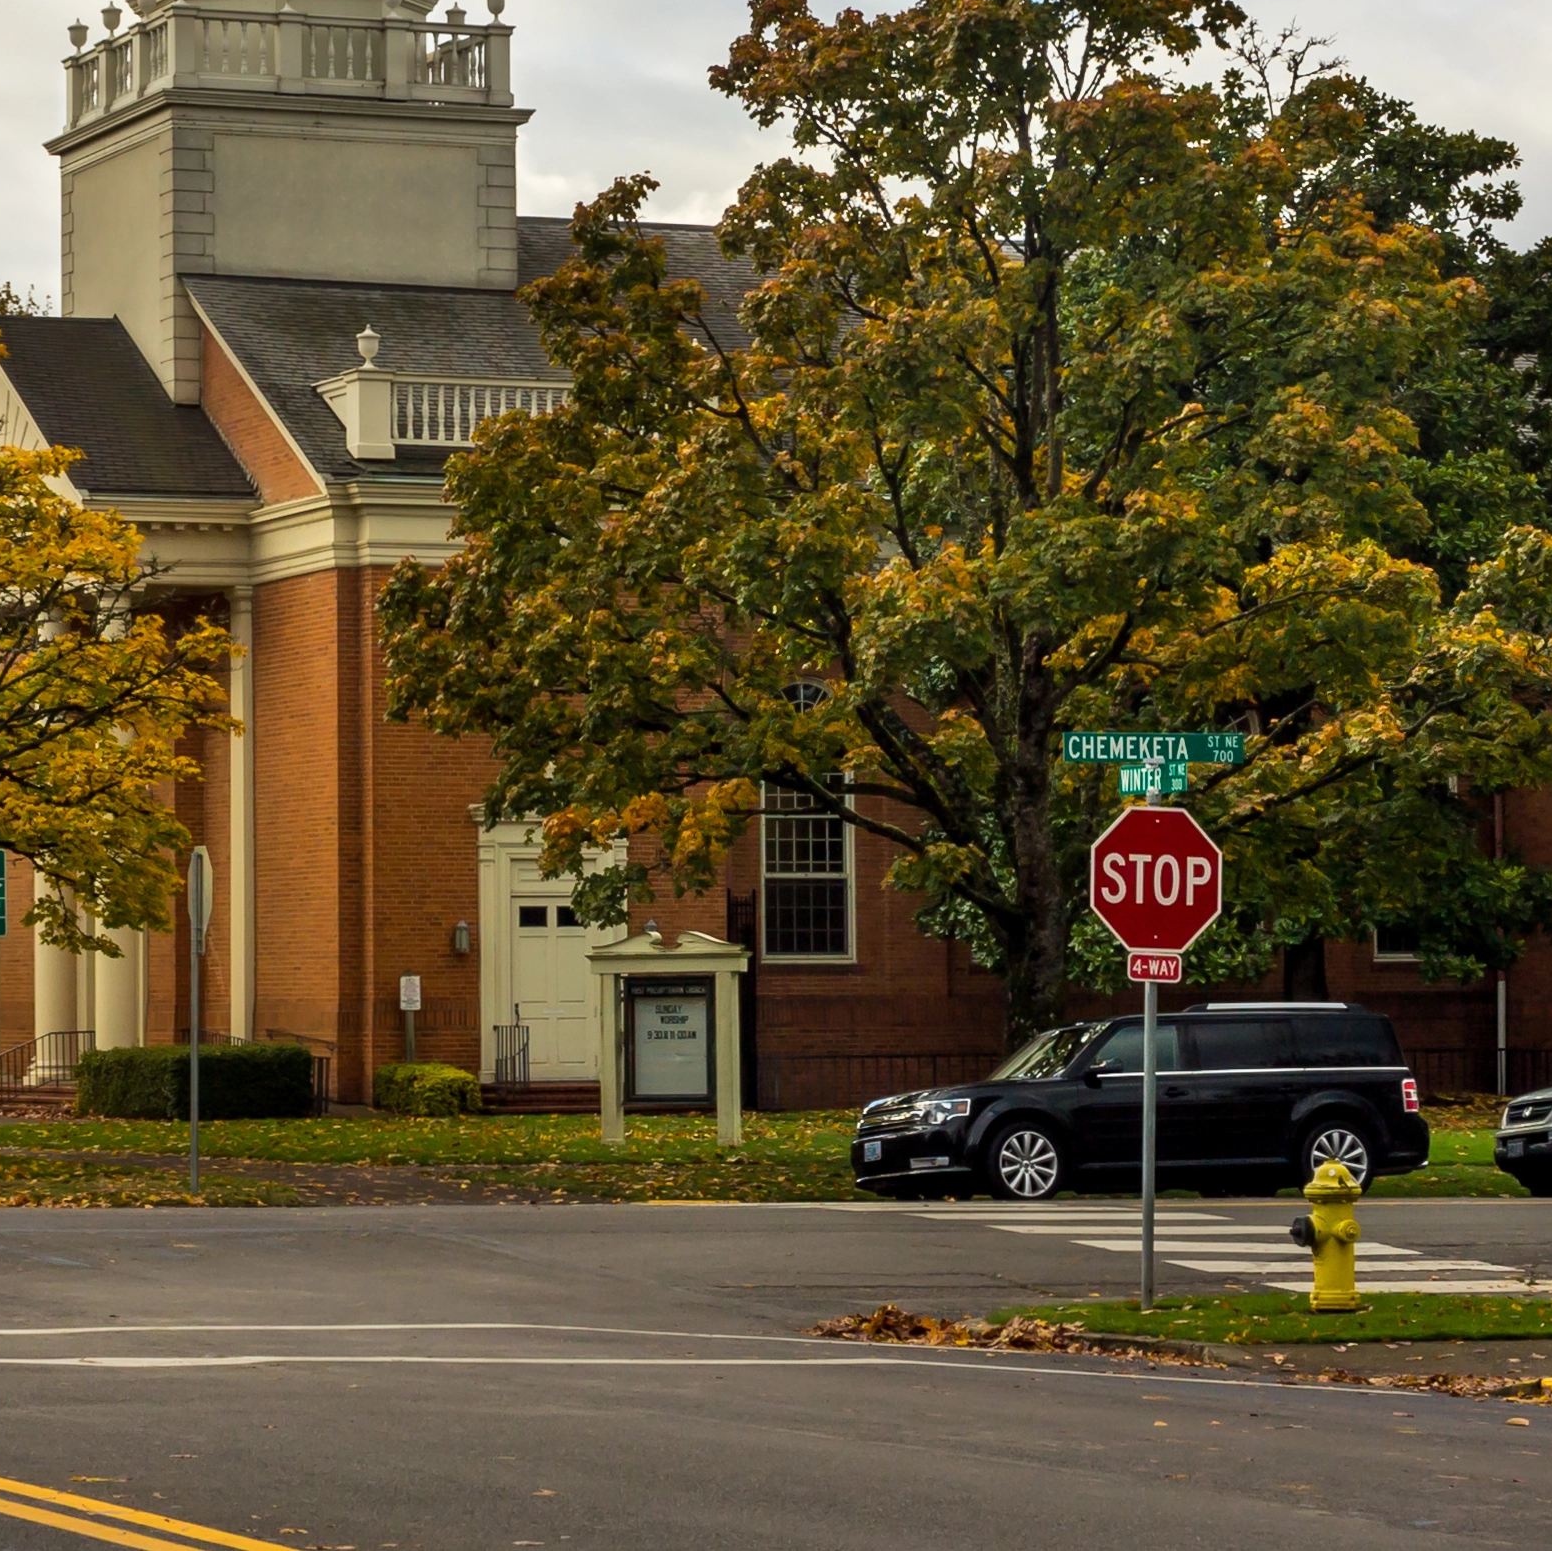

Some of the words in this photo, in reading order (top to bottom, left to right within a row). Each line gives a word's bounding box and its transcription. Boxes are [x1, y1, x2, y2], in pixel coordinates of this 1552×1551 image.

[1068, 736, 1189, 760] CHEMEKETA
[1207, 735, 1220, 748] ST
[1225, 736, 1239, 748] NE
[1212, 750, 1234, 762] 700
[1120, 767, 1162, 793] WINTER
[1168, 763, 1176, 777] ST
[1177, 763, 1186, 776] NE
[1171, 778, 1183, 791] 300
[1101, 852, 1212, 906] STOP
[1132, 959, 1177, 976] 4-WAY
